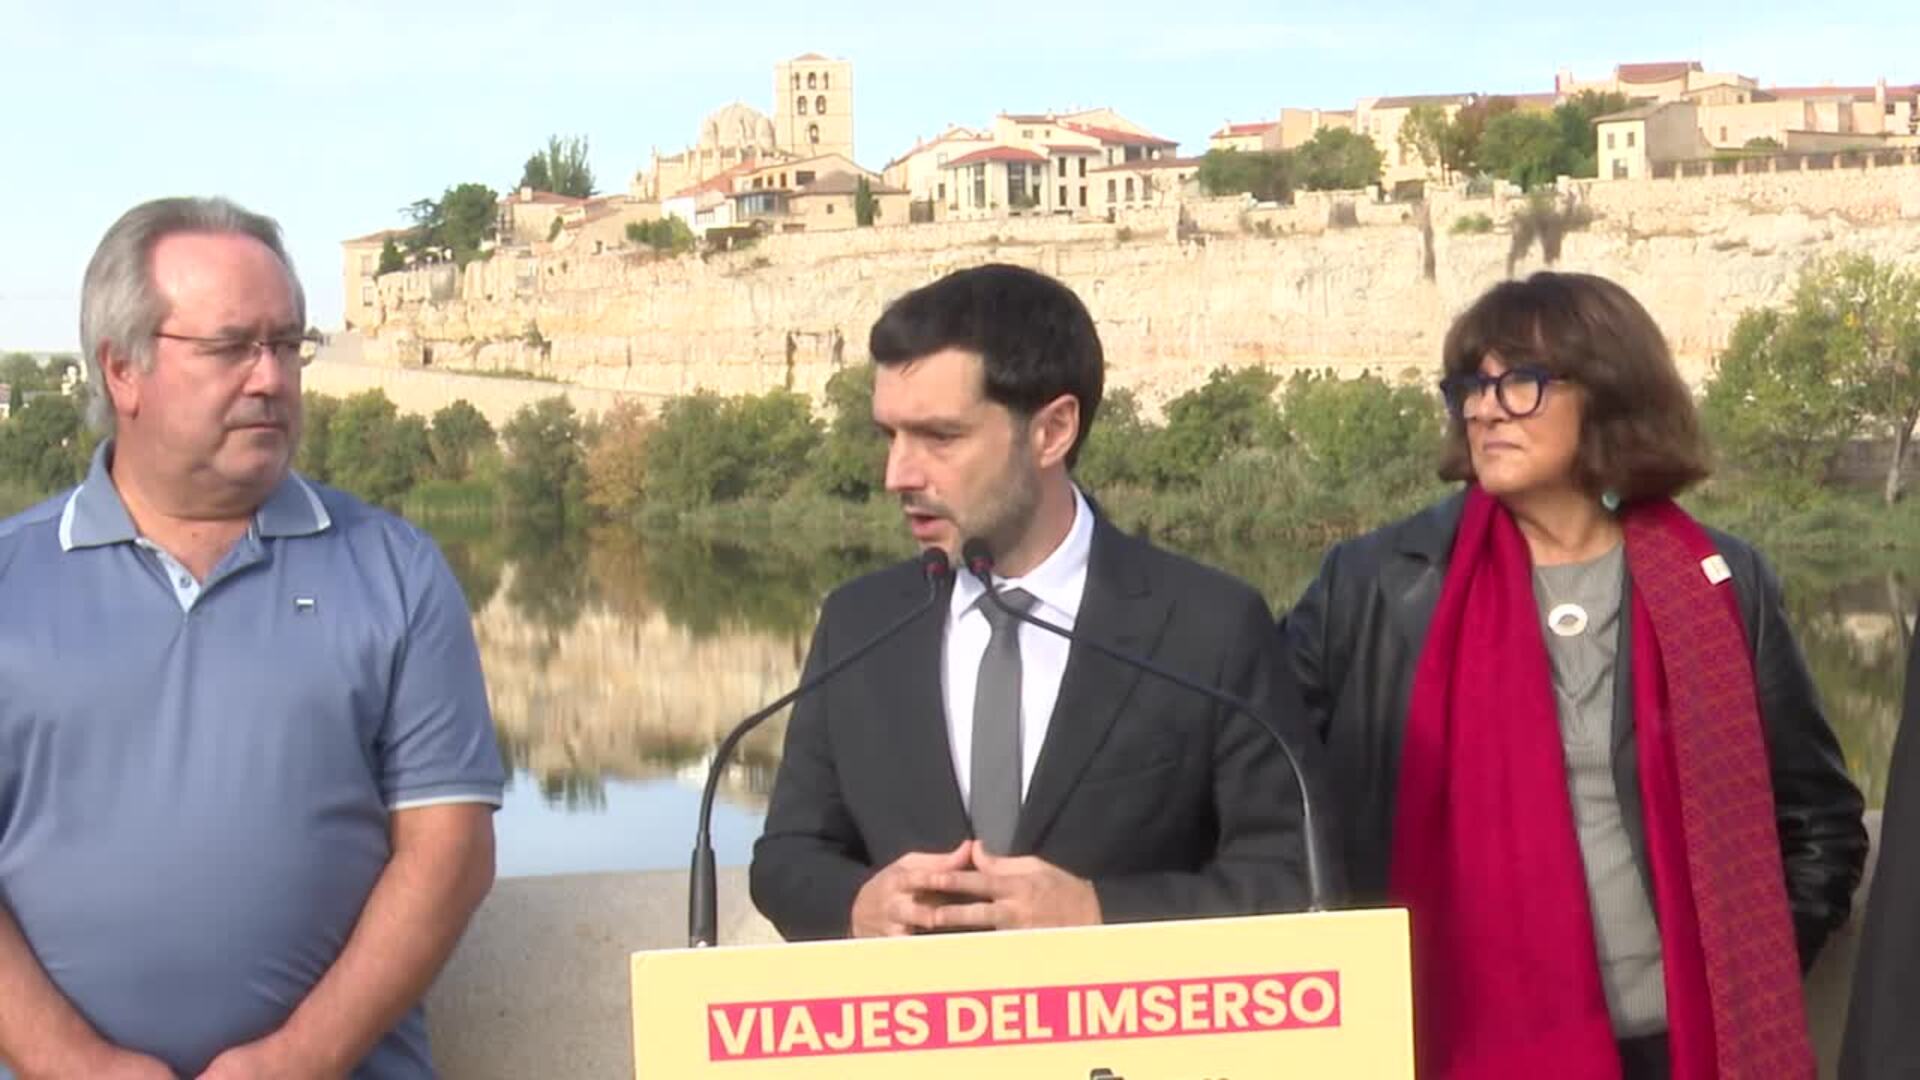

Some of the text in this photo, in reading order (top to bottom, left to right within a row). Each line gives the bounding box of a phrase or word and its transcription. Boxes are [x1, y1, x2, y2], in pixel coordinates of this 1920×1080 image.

[712, 976, 1336, 1056] VIAJES DEL IMSERSO
